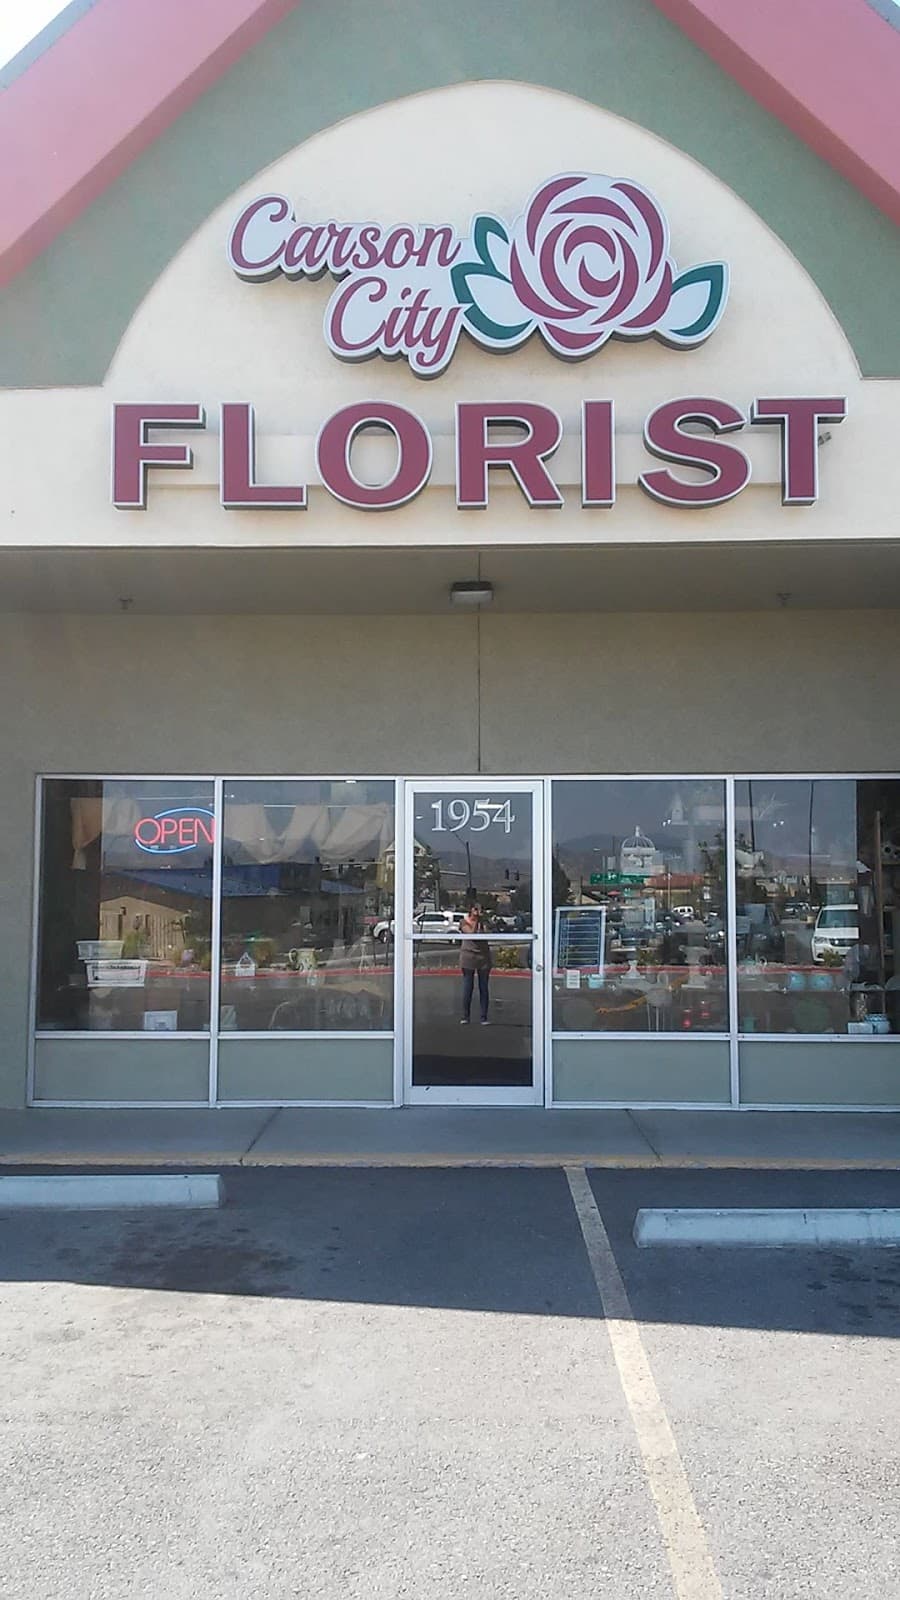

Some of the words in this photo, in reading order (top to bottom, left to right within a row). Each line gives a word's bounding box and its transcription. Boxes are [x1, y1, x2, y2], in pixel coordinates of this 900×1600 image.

[230, 196, 461, 271] Carson
[330, 276, 463, 368] City
[112, 397, 848, 510] FLORIST
[133, 817, 215, 845] OPEN
[431, 798, 515, 834] 1954
